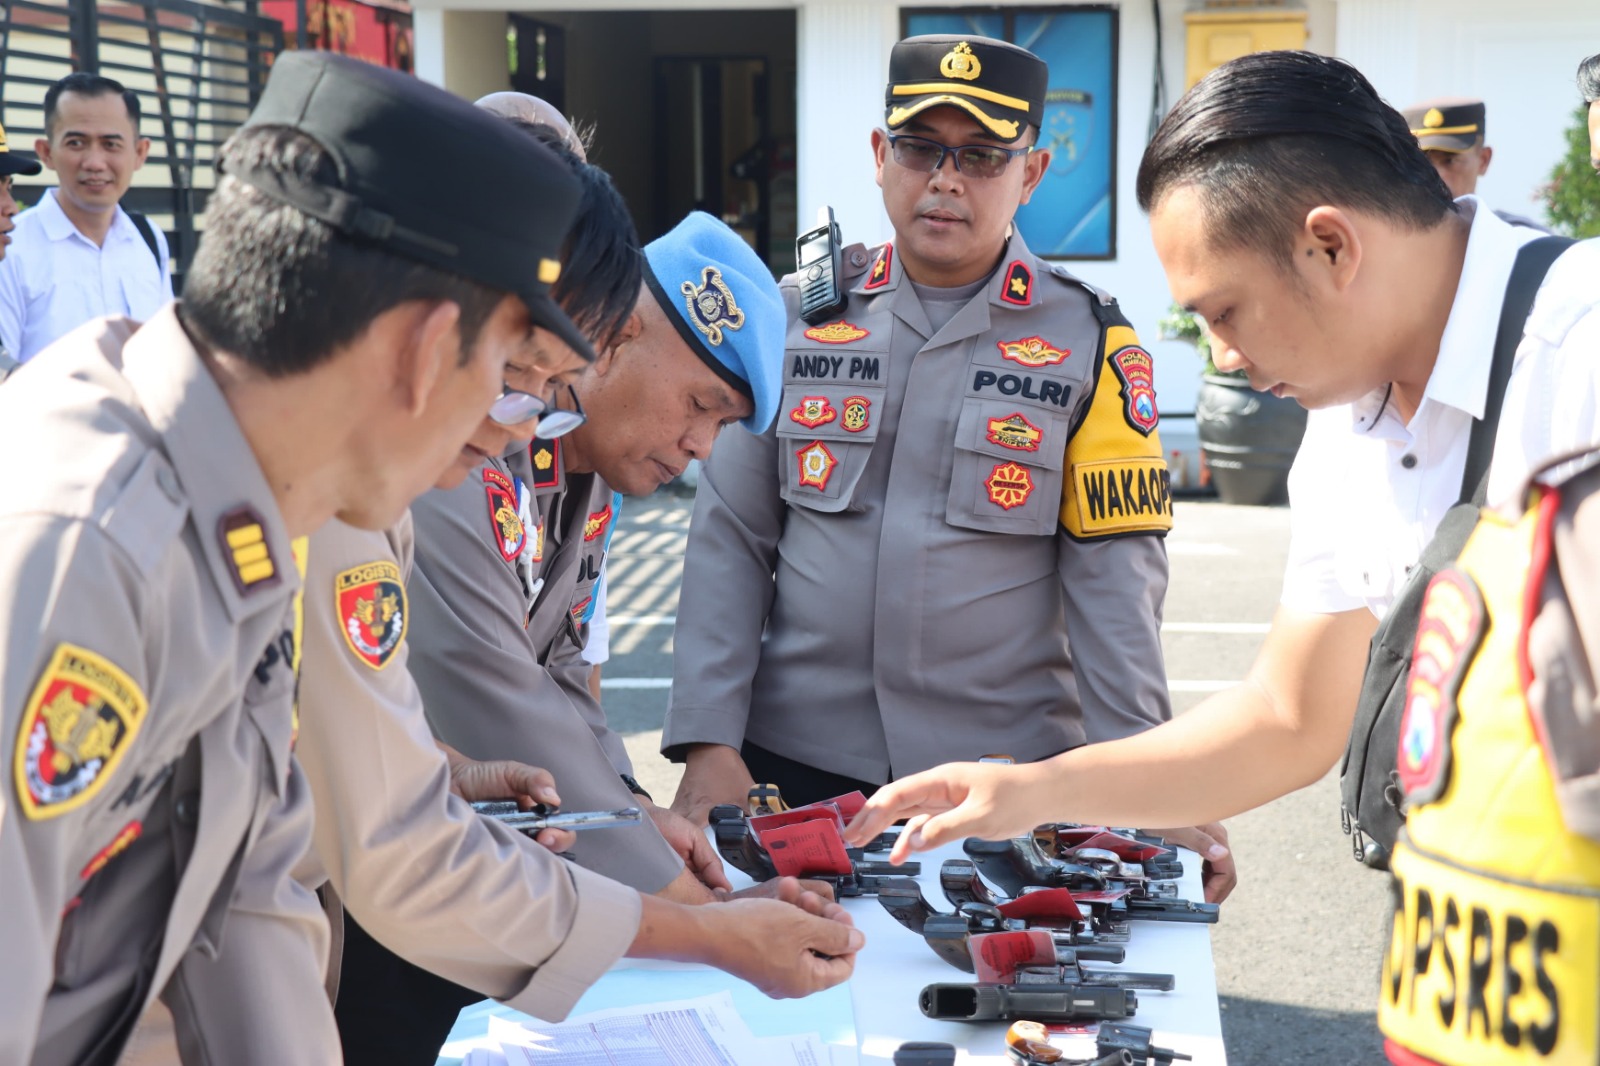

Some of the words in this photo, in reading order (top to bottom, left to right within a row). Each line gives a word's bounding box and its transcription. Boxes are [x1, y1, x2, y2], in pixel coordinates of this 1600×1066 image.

[792, 355, 843, 378] ANDY
[849, 357, 879, 380] PM
[973, 370, 1071, 407] POLRI
